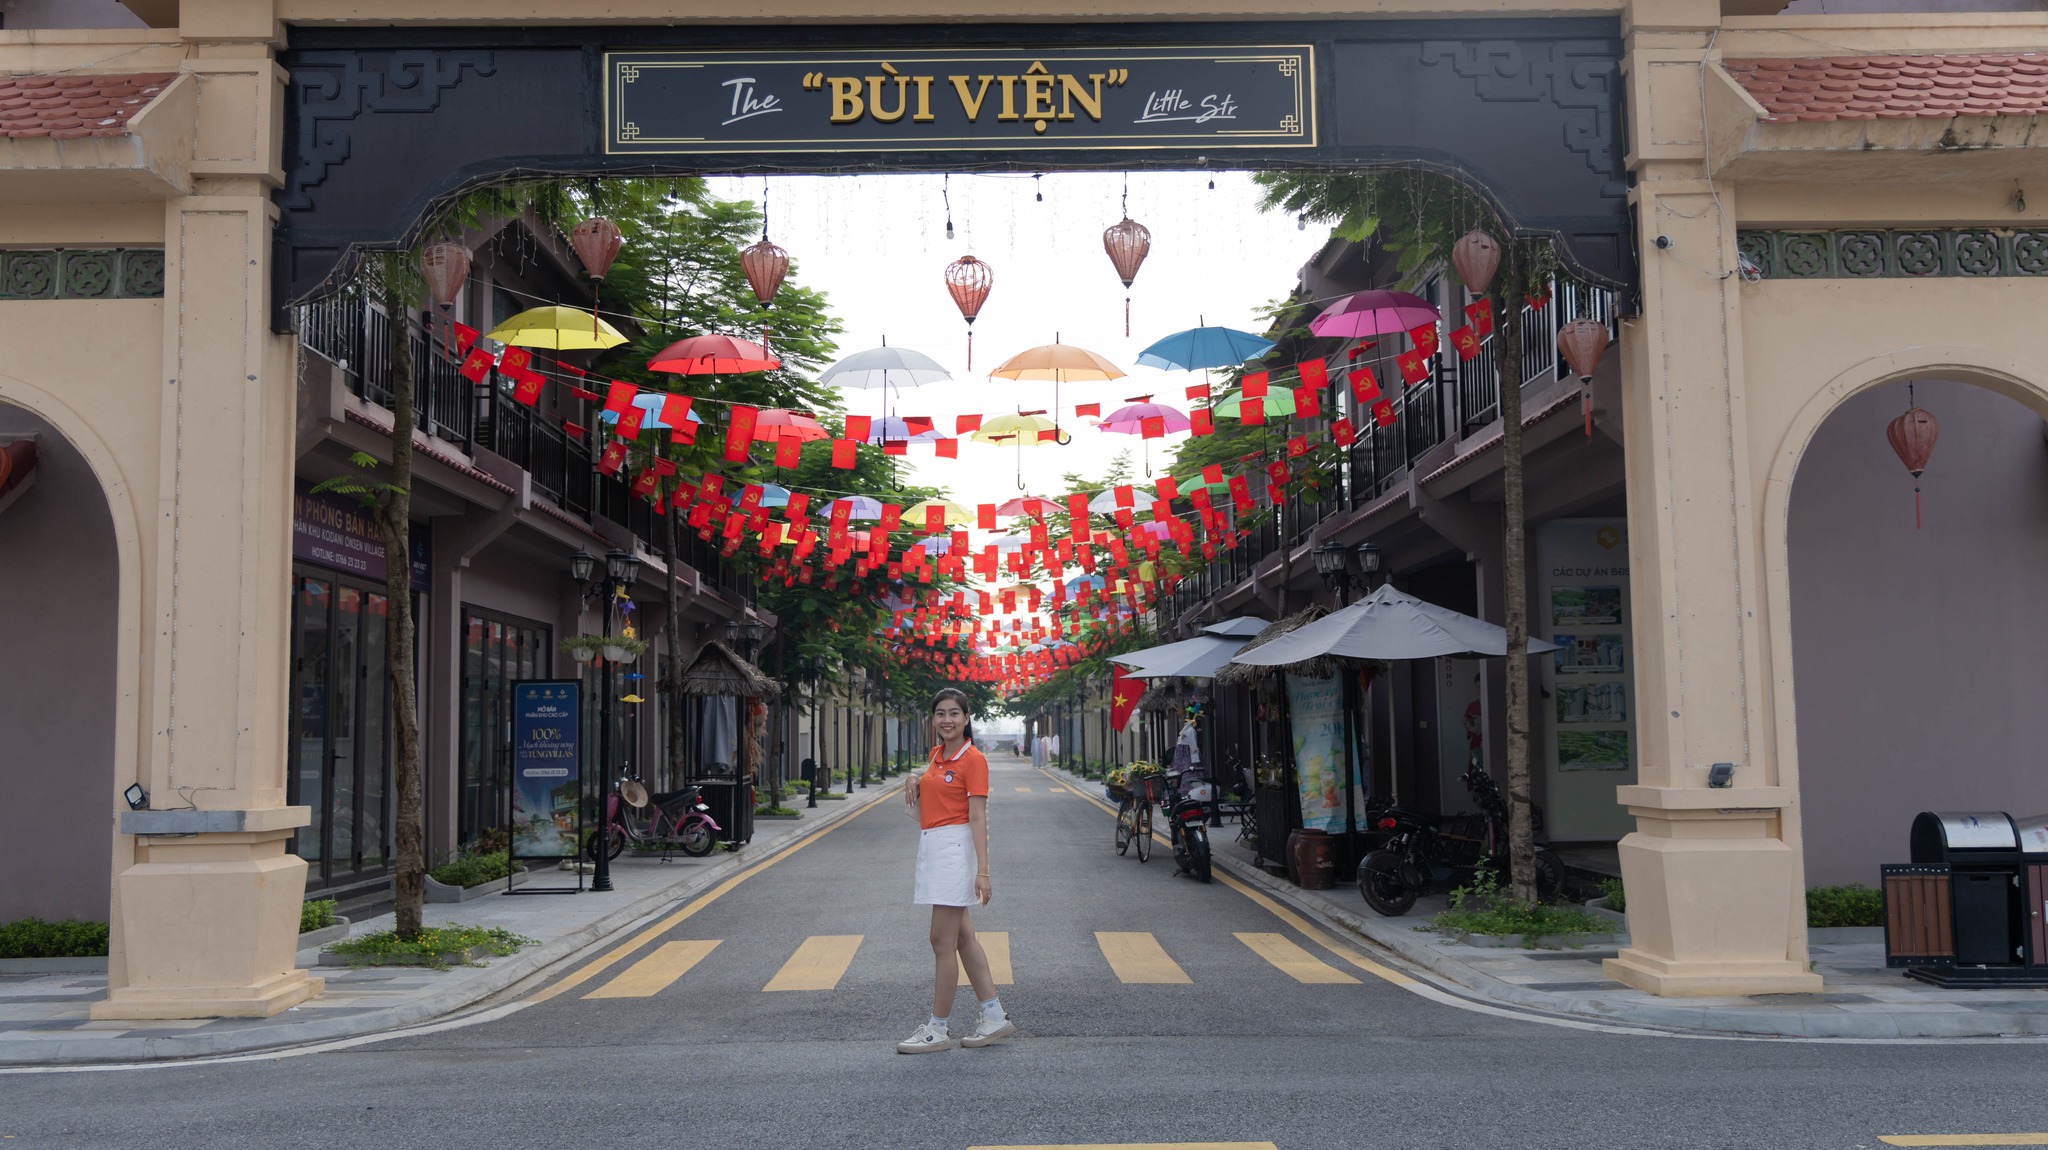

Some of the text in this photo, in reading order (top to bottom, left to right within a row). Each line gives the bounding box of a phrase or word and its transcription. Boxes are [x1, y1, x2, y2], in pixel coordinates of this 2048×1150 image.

[722, 77, 783, 117] The
[1143, 89, 1193, 120] Little
[1196, 93, 1238, 123] Str
[306, 498, 343, 529] PHÒNG
[345, 511, 365, 537] BÁN
[308, 524, 321, 538] KHU
[322, 528, 344, 546] KODANI
[345, 536, 363, 552] ONSEN
[364, 541, 385, 558] VILLAGE
[336, 553, 347, 565] 0766
[1552, 566, 1573, 577] CÁC
[1576, 568, 1592, 578] DỰ
[1594, 566, 1608, 576] ÁN
[532, 728, 561, 740] 100%
